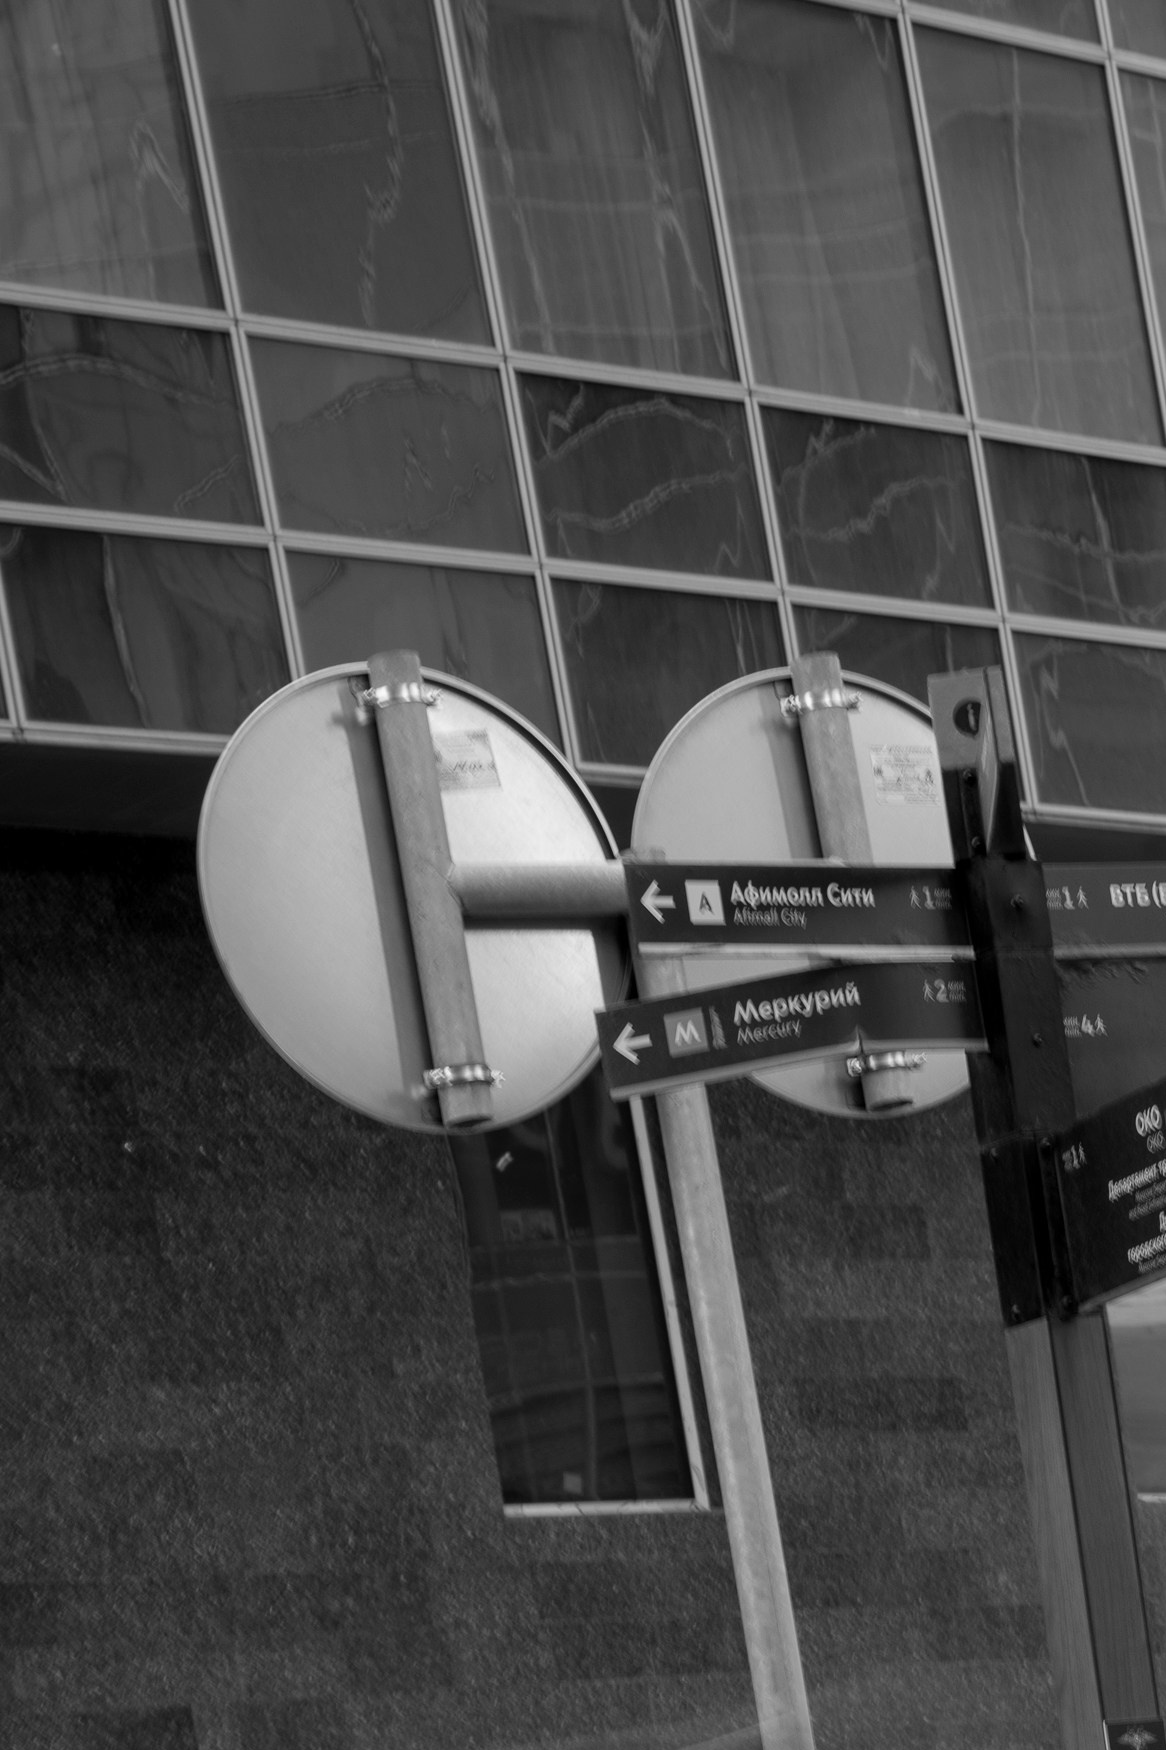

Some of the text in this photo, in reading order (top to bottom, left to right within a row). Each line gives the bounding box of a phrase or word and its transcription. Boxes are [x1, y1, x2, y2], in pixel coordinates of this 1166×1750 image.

[731, 880, 824, 910] Афимолл
[827, 882, 876, 908] Сити
[1109, 883, 1150, 908] ВТБ
[781, 907, 807, 930] City
[734, 981, 861, 1026] Меркурий
[934, 979, 949, 1002] 2
[737, 1019, 802, 1046] Mercury
[1081, 1014, 1095, 1037] 4
[1135, 1104, 1163, 1137] ОКО
